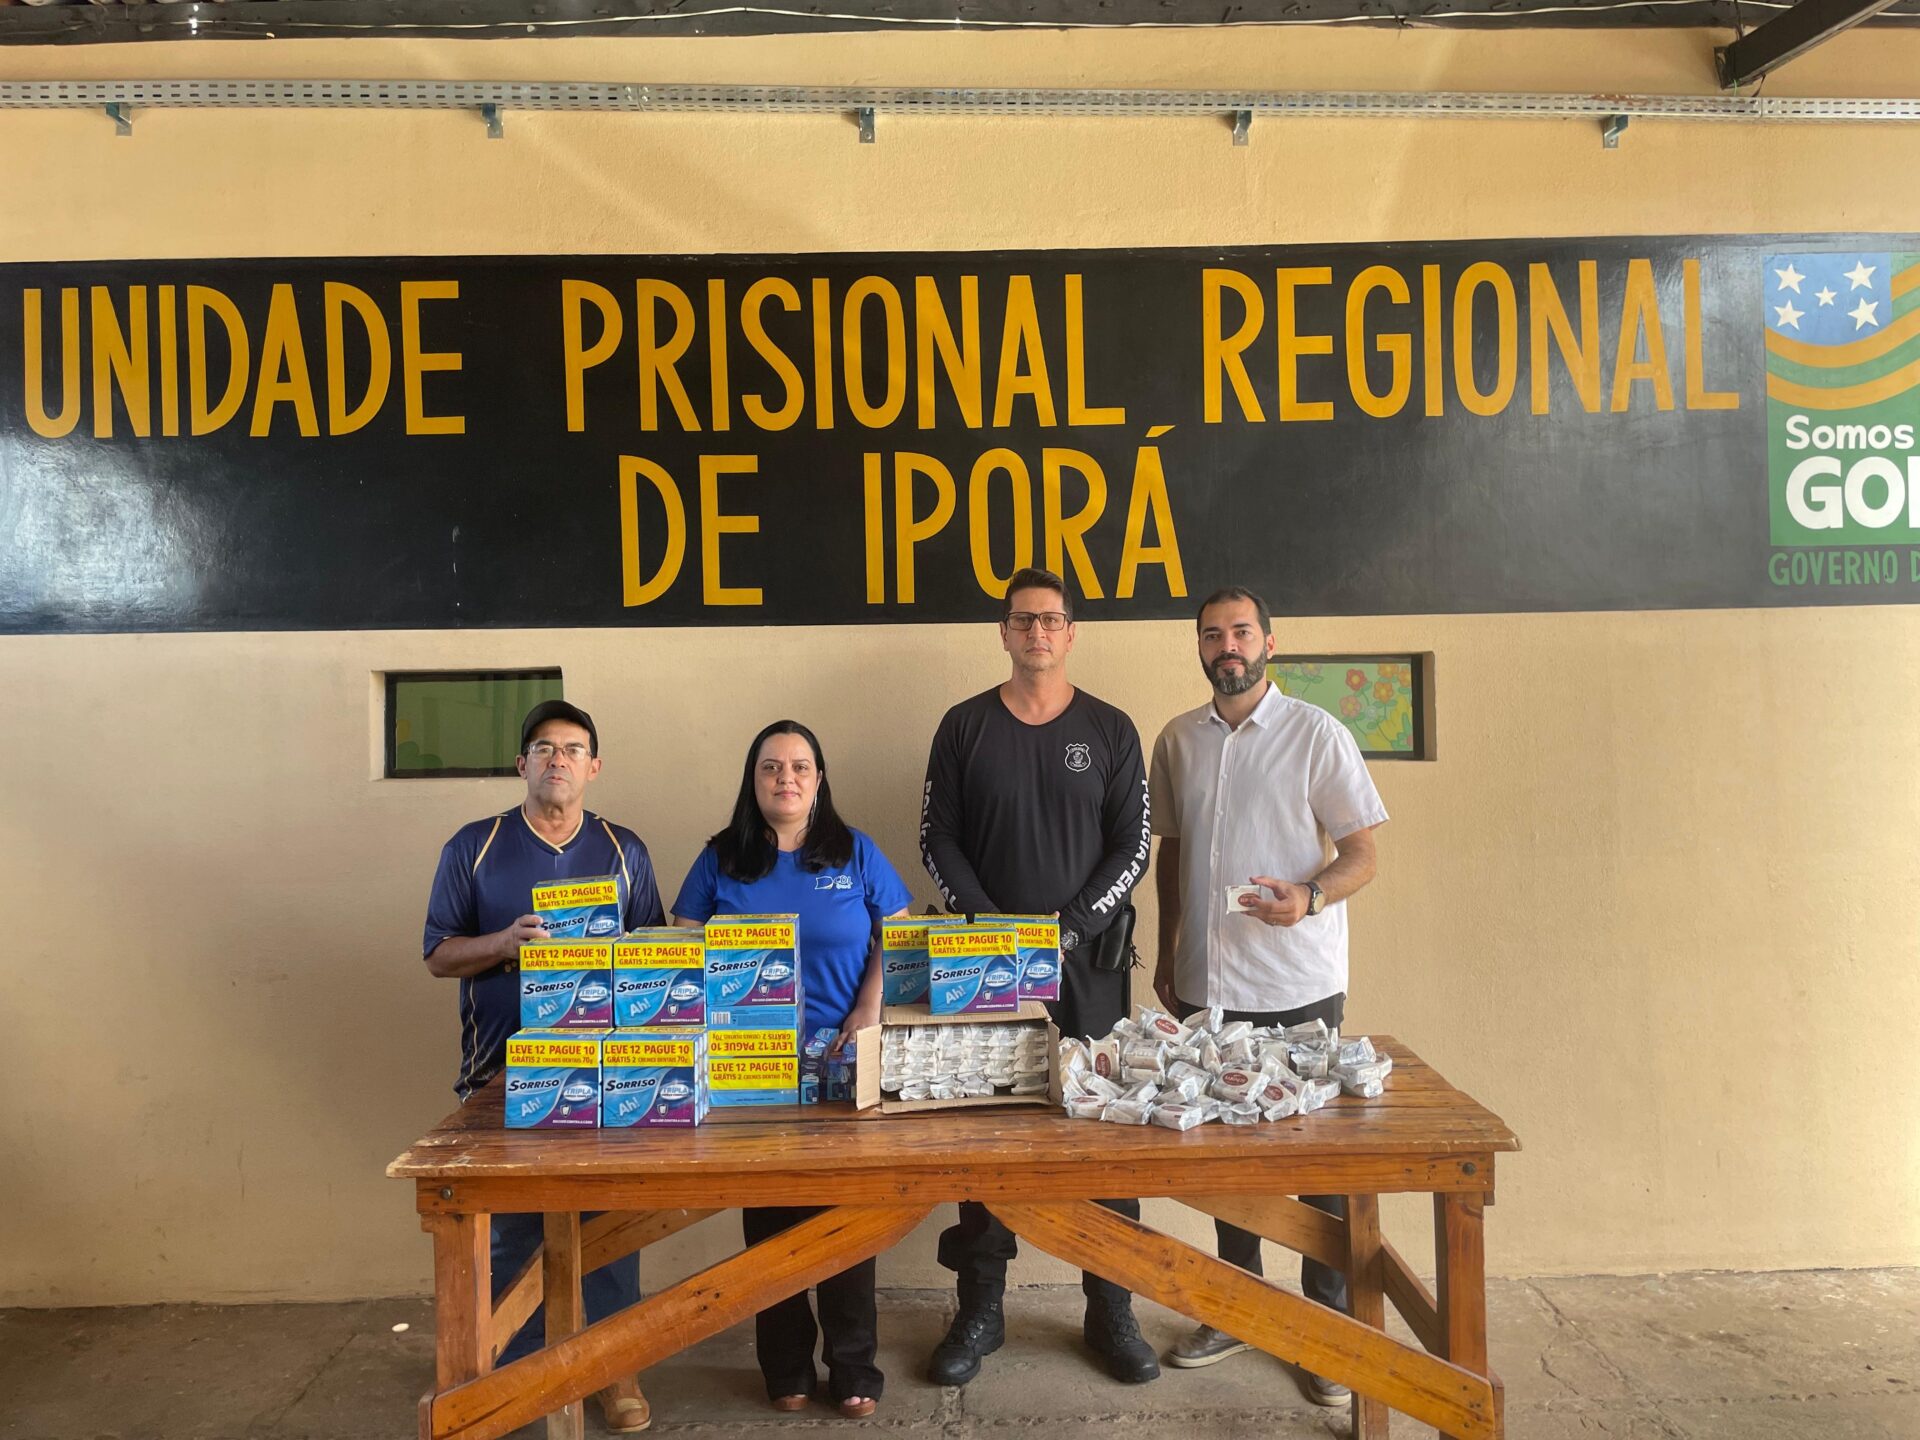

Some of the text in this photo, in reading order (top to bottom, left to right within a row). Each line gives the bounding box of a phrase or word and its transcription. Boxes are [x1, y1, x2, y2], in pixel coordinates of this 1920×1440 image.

[24, 258, 1739, 438] UNIDADE PRISIONAL REGIONAL
[1785, 414, 1915, 450] Somos
[619, 425, 1188, 607] DE IPORÁ
[1768, 550, 1898, 585] GOVERNO
[536, 885, 613, 900] LEVE 12 PAGUE 10
[1091, 860, 1141, 914] PENAL
[541, 917, 584, 930] SORRISO
[708, 928, 790, 938] LEVE 12 PAGUE 10
[886, 931, 908, 939] LEVE
[1045, 929, 1055, 937] 10
[932, 937, 953, 946] LEVE
[956, 937, 965, 945] 12
[969, 935, 998, 944] PAGUE
[1001, 935, 1011, 943] 10
[524, 949, 607, 958] LEVE 12 PAGUE 10
[618, 948, 700, 956] LEVE 12 PAGUE 10
[708, 961, 757, 973] SORRISO
[932, 967, 980, 981] SORRISO
[524, 982, 574, 994] SORRISO
[617, 980, 667, 992] SORRISO
[721, 978, 742, 997] Ah!
[945, 985, 966, 1005] Ah!
[537, 1000, 558, 1019] Ah!
[630, 998, 651, 1017] Ah!
[510, 1045, 595, 1055] LEVE 12 PAGUE 10
[605, 1045, 689, 1054] LEVE 12 PAGUE 10
[711, 1042, 793, 1051] LEVE 12 PAGUE 10
[712, 1063, 793, 1072] LEVE 12 PAGUE 10
[508, 1080, 559, 1091] SORRISO
[605, 1079, 656, 1091] SORRISO
[521, 1097, 542, 1117] Ah!
[619, 1097, 640, 1116] Ah!
